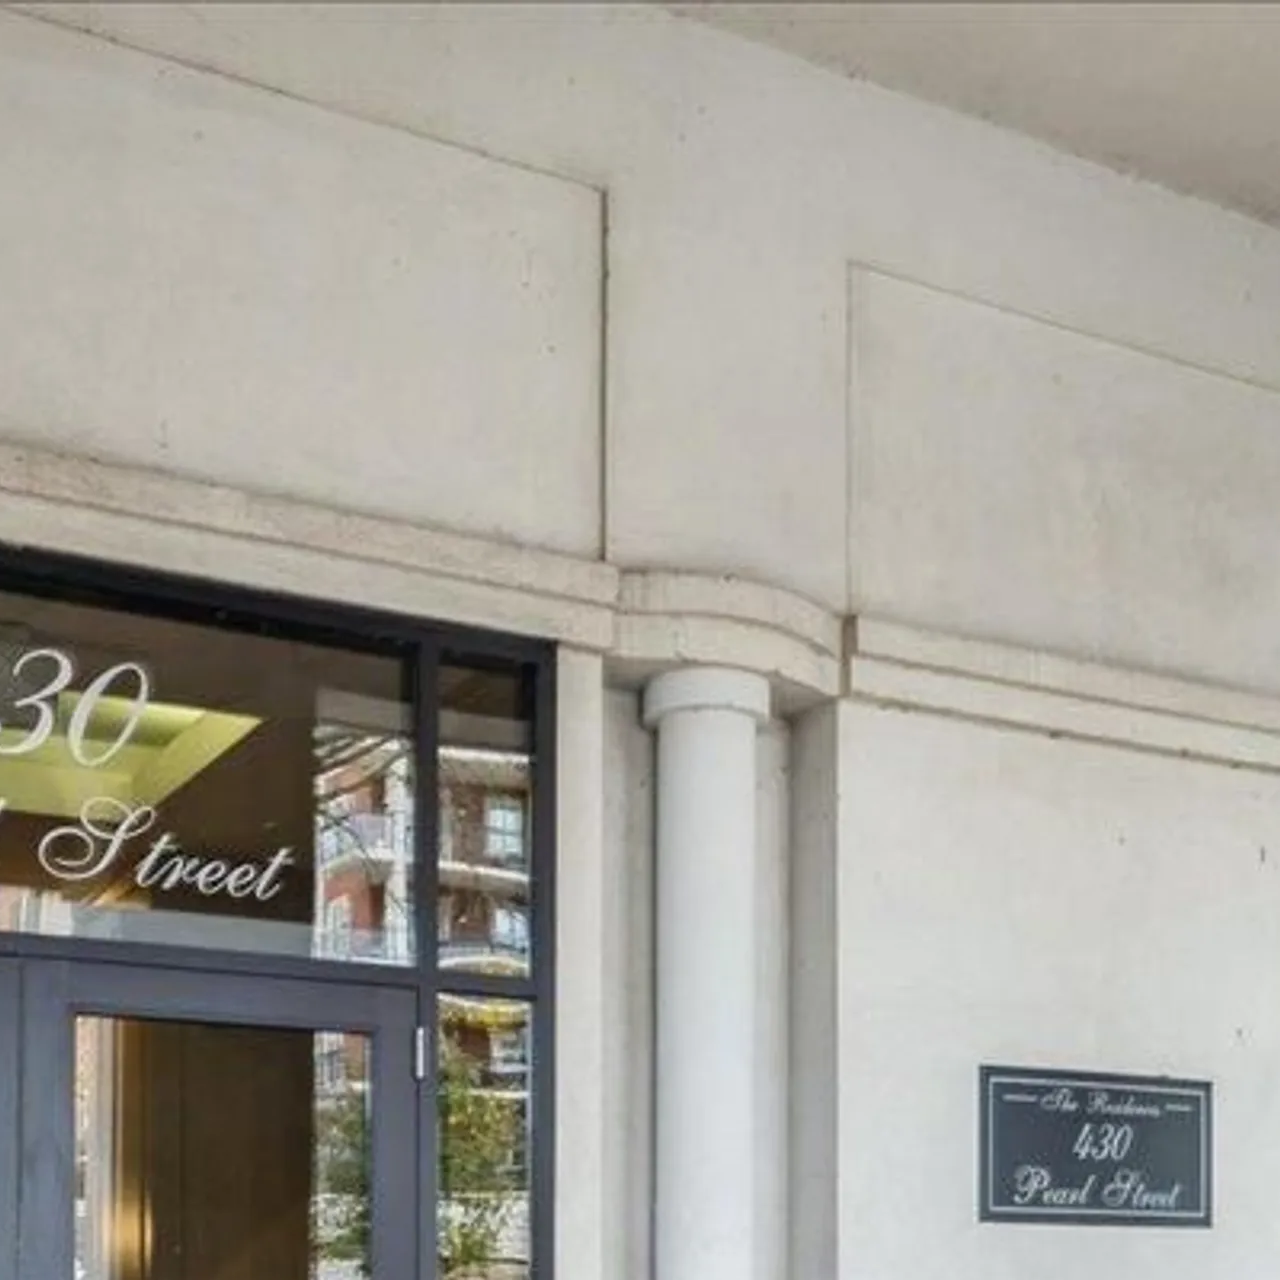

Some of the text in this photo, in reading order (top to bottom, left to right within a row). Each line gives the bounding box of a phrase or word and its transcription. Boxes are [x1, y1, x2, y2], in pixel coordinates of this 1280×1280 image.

[38, 796, 295, 901] Street
[1073, 1123, 1134, 1160] 430
[1013, 1165, 1181, 1208] Pearl Street
